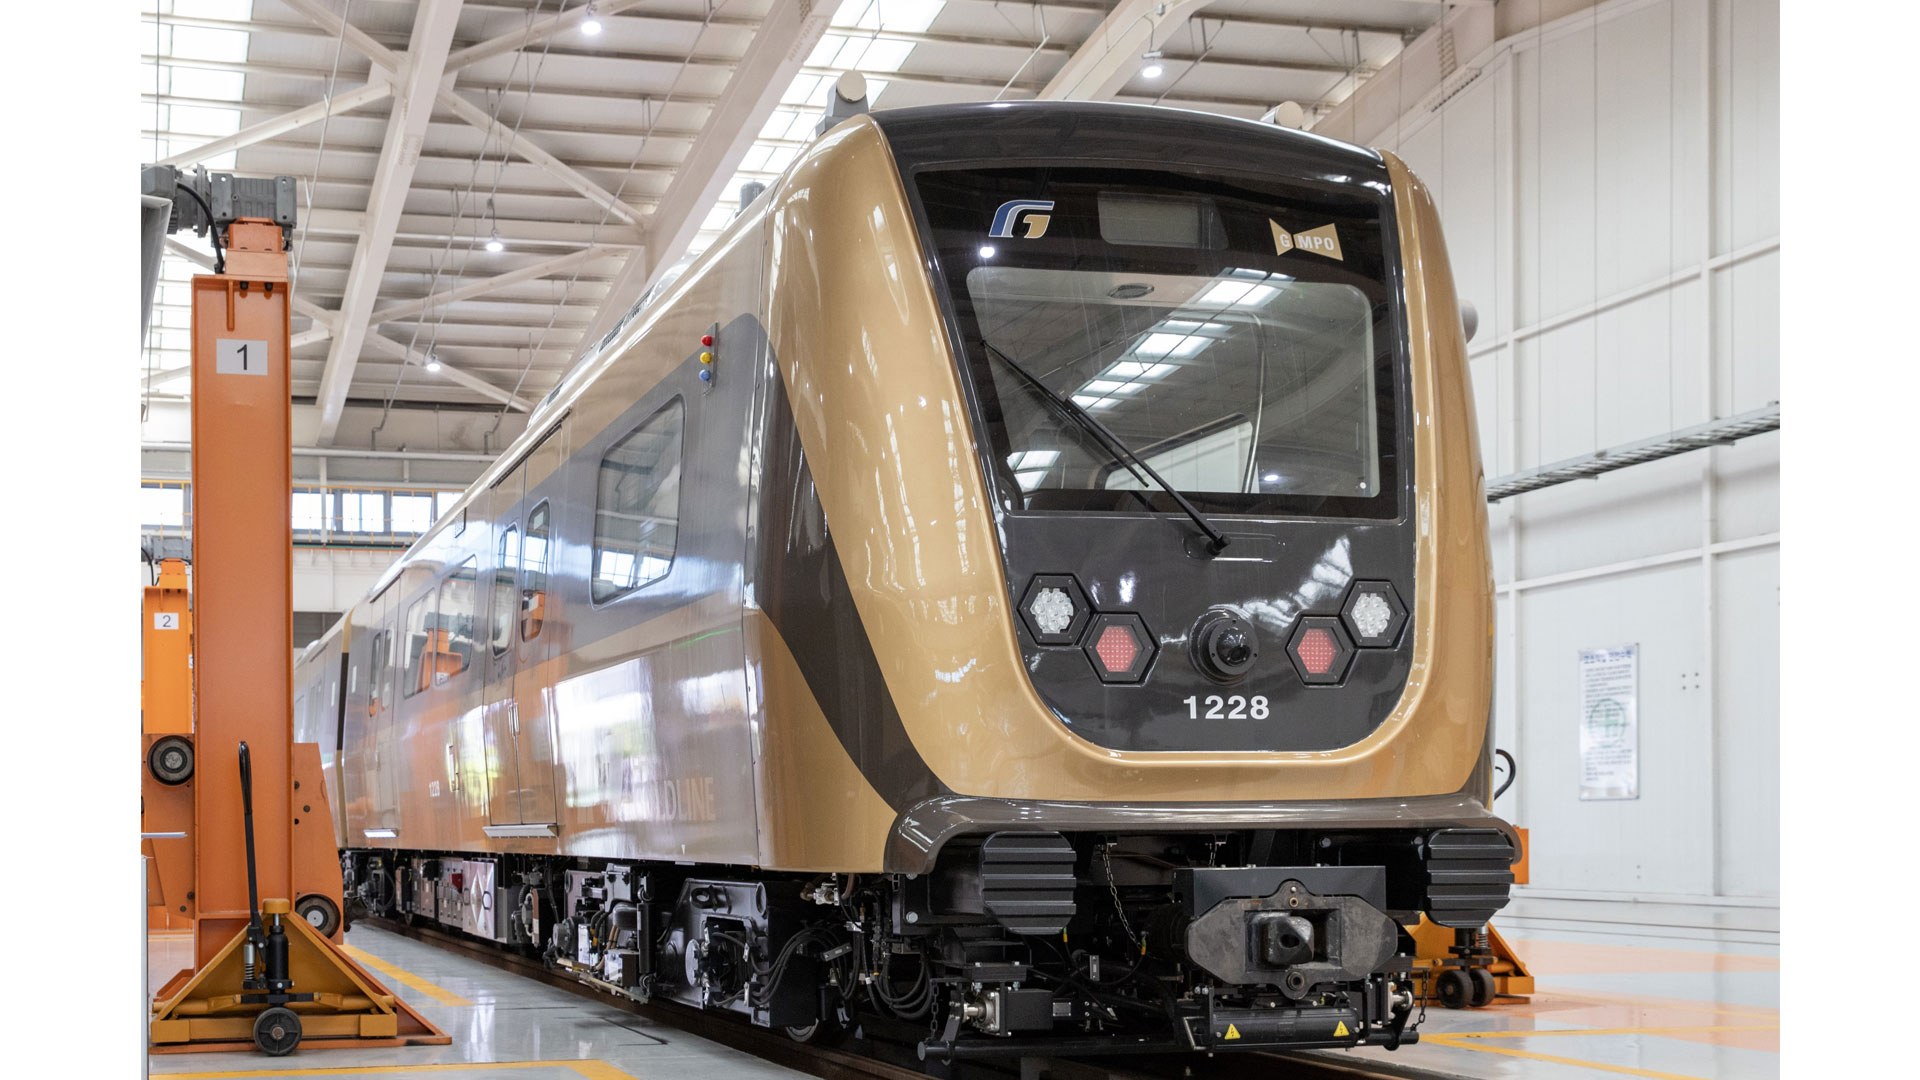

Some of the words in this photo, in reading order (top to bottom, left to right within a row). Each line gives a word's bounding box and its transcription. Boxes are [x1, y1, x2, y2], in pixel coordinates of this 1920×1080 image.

[237, 344, 247, 370] 1
[162, 615, 171, 628] 2
[1183, 695, 1270, 720] 1228
